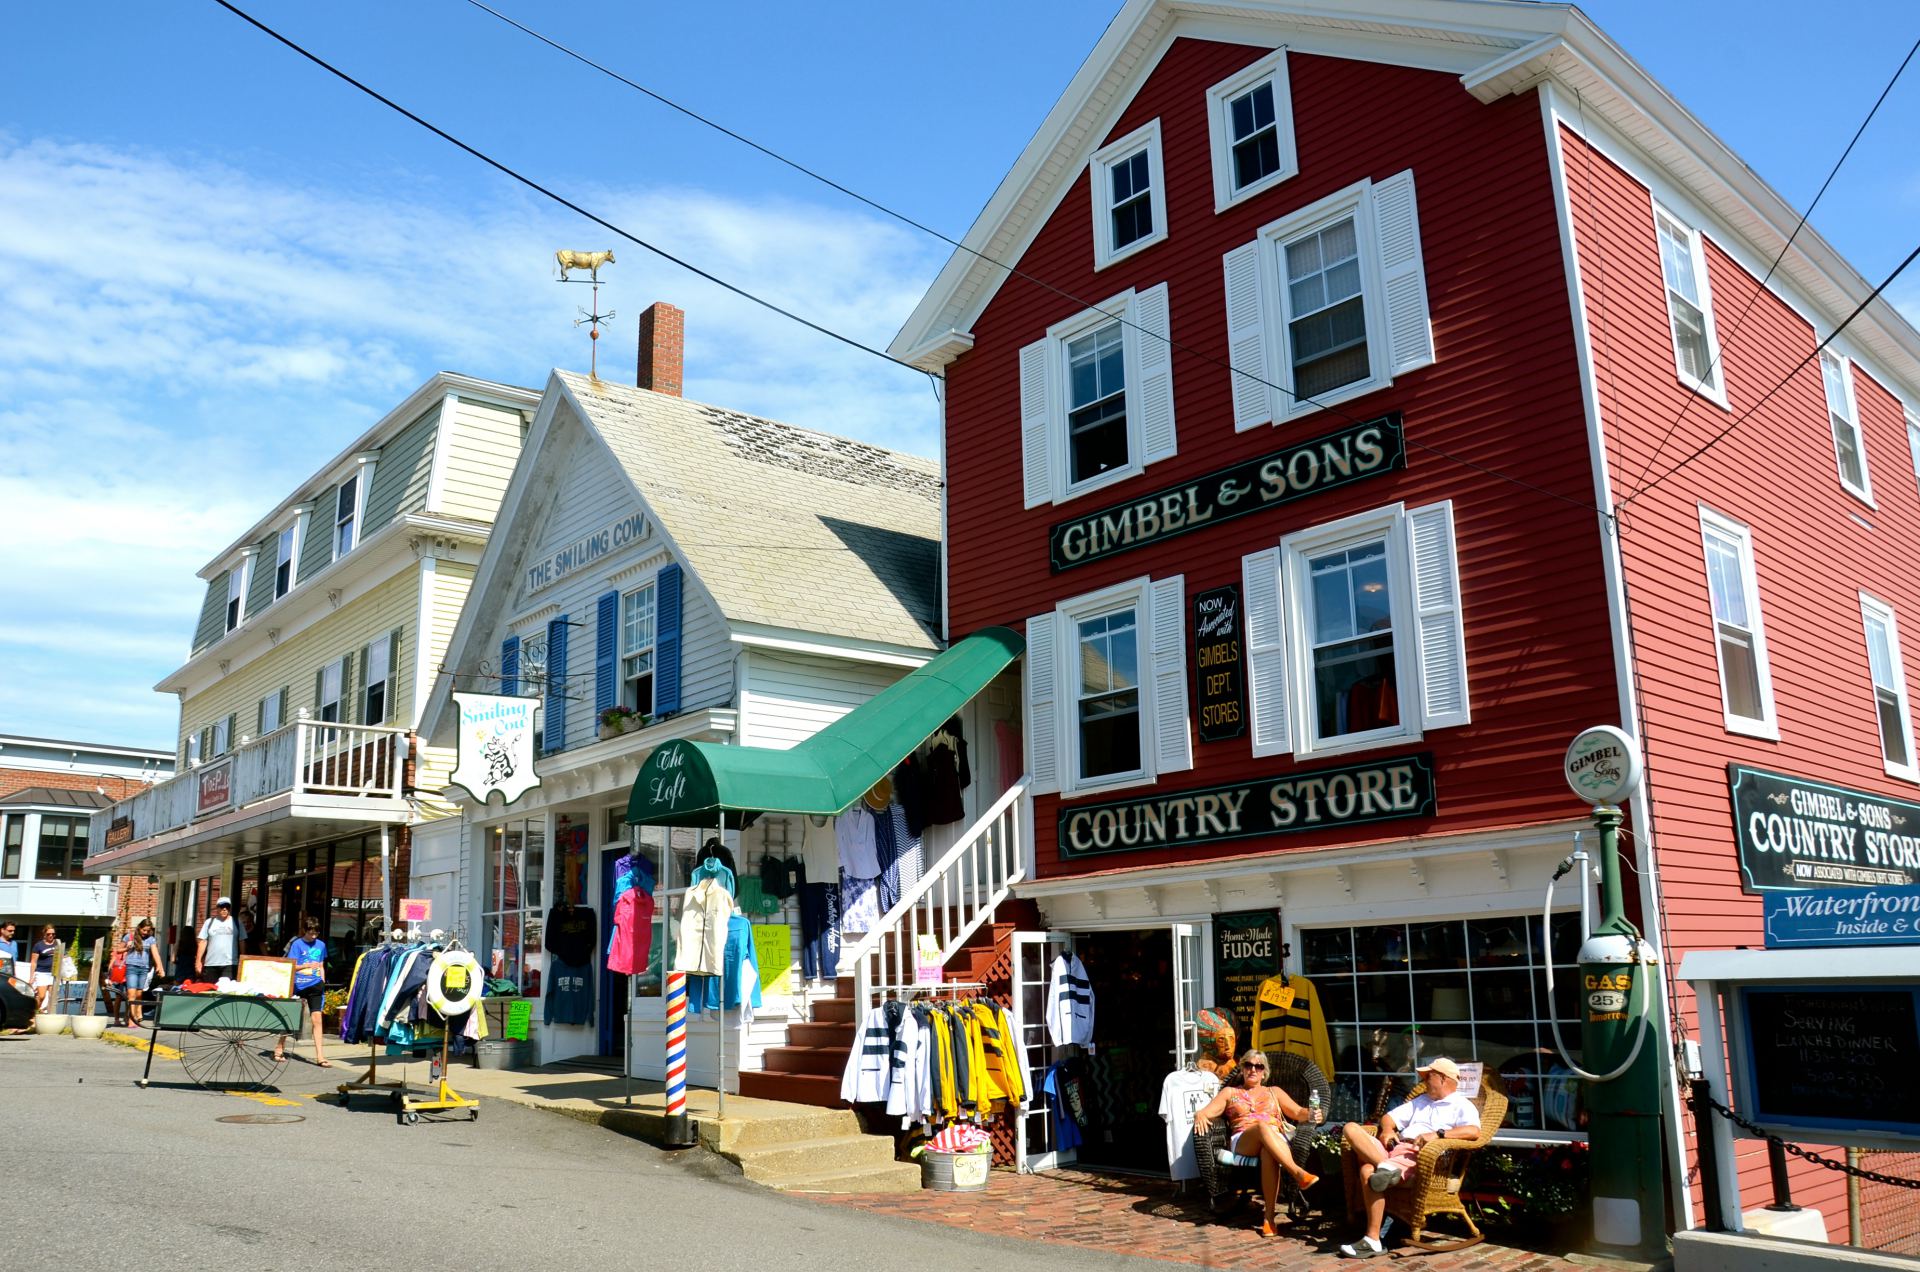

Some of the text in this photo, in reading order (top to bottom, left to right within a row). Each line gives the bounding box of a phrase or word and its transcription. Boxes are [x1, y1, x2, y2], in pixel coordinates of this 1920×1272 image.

[1062, 428, 1384, 561] GIMBEL & SONS
[529, 512, 644, 589] THE SMILING COW
[1199, 597, 1223, 613] NOW
[1216, 617, 1234, 637] with
[1198, 641, 1238, 668] GIMBELS
[1207, 672, 1232, 696] DEPT.
[462, 702, 526, 725] Smiling
[1203, 701, 1239, 727] STORES
[495, 716, 529, 735] Cow
[656, 744, 684, 771] The
[1570, 747, 1621, 773] GIMBEL
[1594, 760, 1620, 781] Sons
[649, 770, 686, 809] Loft
[1069, 766, 1416, 851] COUNTRY STORE
[1791, 789, 1892, 830] GIMBEL & SONS
[1749, 811, 1856, 861] COUNTRY
[1796, 864, 1812, 878] NOW
[1844, 868, 1856, 881] WITH
[1221, 927, 1272, 942] Home Made
[1835, 921, 1888, 935] Inside
[1893, 918, 1908, 933] &
[1223, 941, 1272, 959] FUDGE
[1585, 974, 1632, 990] GAS
[510, 1002, 529, 1012] FREE
